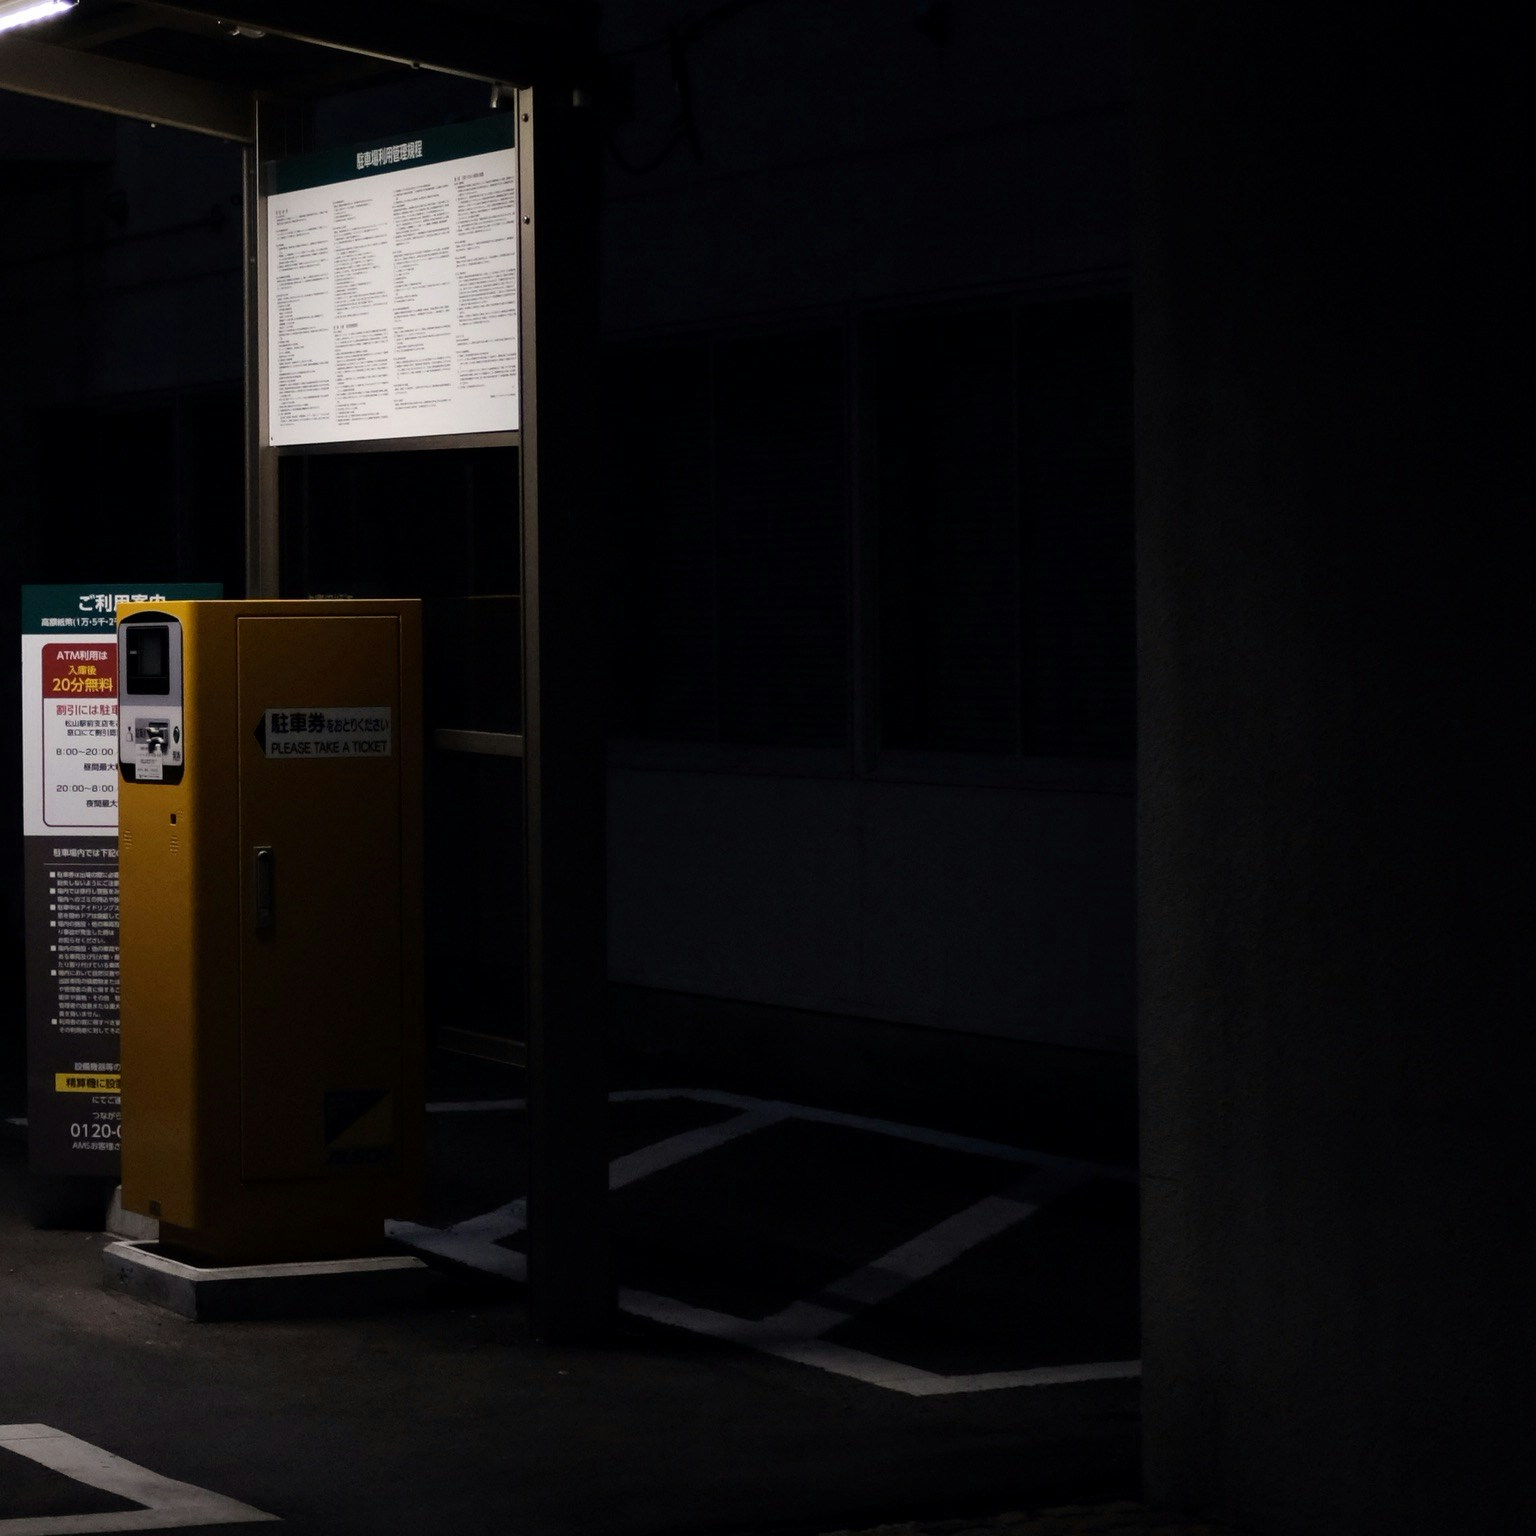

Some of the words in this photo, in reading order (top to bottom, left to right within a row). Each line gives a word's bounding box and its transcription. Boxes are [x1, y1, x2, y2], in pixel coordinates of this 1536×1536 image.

[56, 650, 108, 661] ATM利用は
[68, 665, 97, 676] 入庫後
[52, 677, 113, 692] 20分無料
[271, 713, 389, 733] 駐車券をおとりください
[271, 742, 311, 754] PLEASE
[315, 741, 339, 753] TAKE
[342, 742, 350, 753] A
[352, 740, 387, 753] TICKET
[83, 762, 118, 771] 昼間最大
